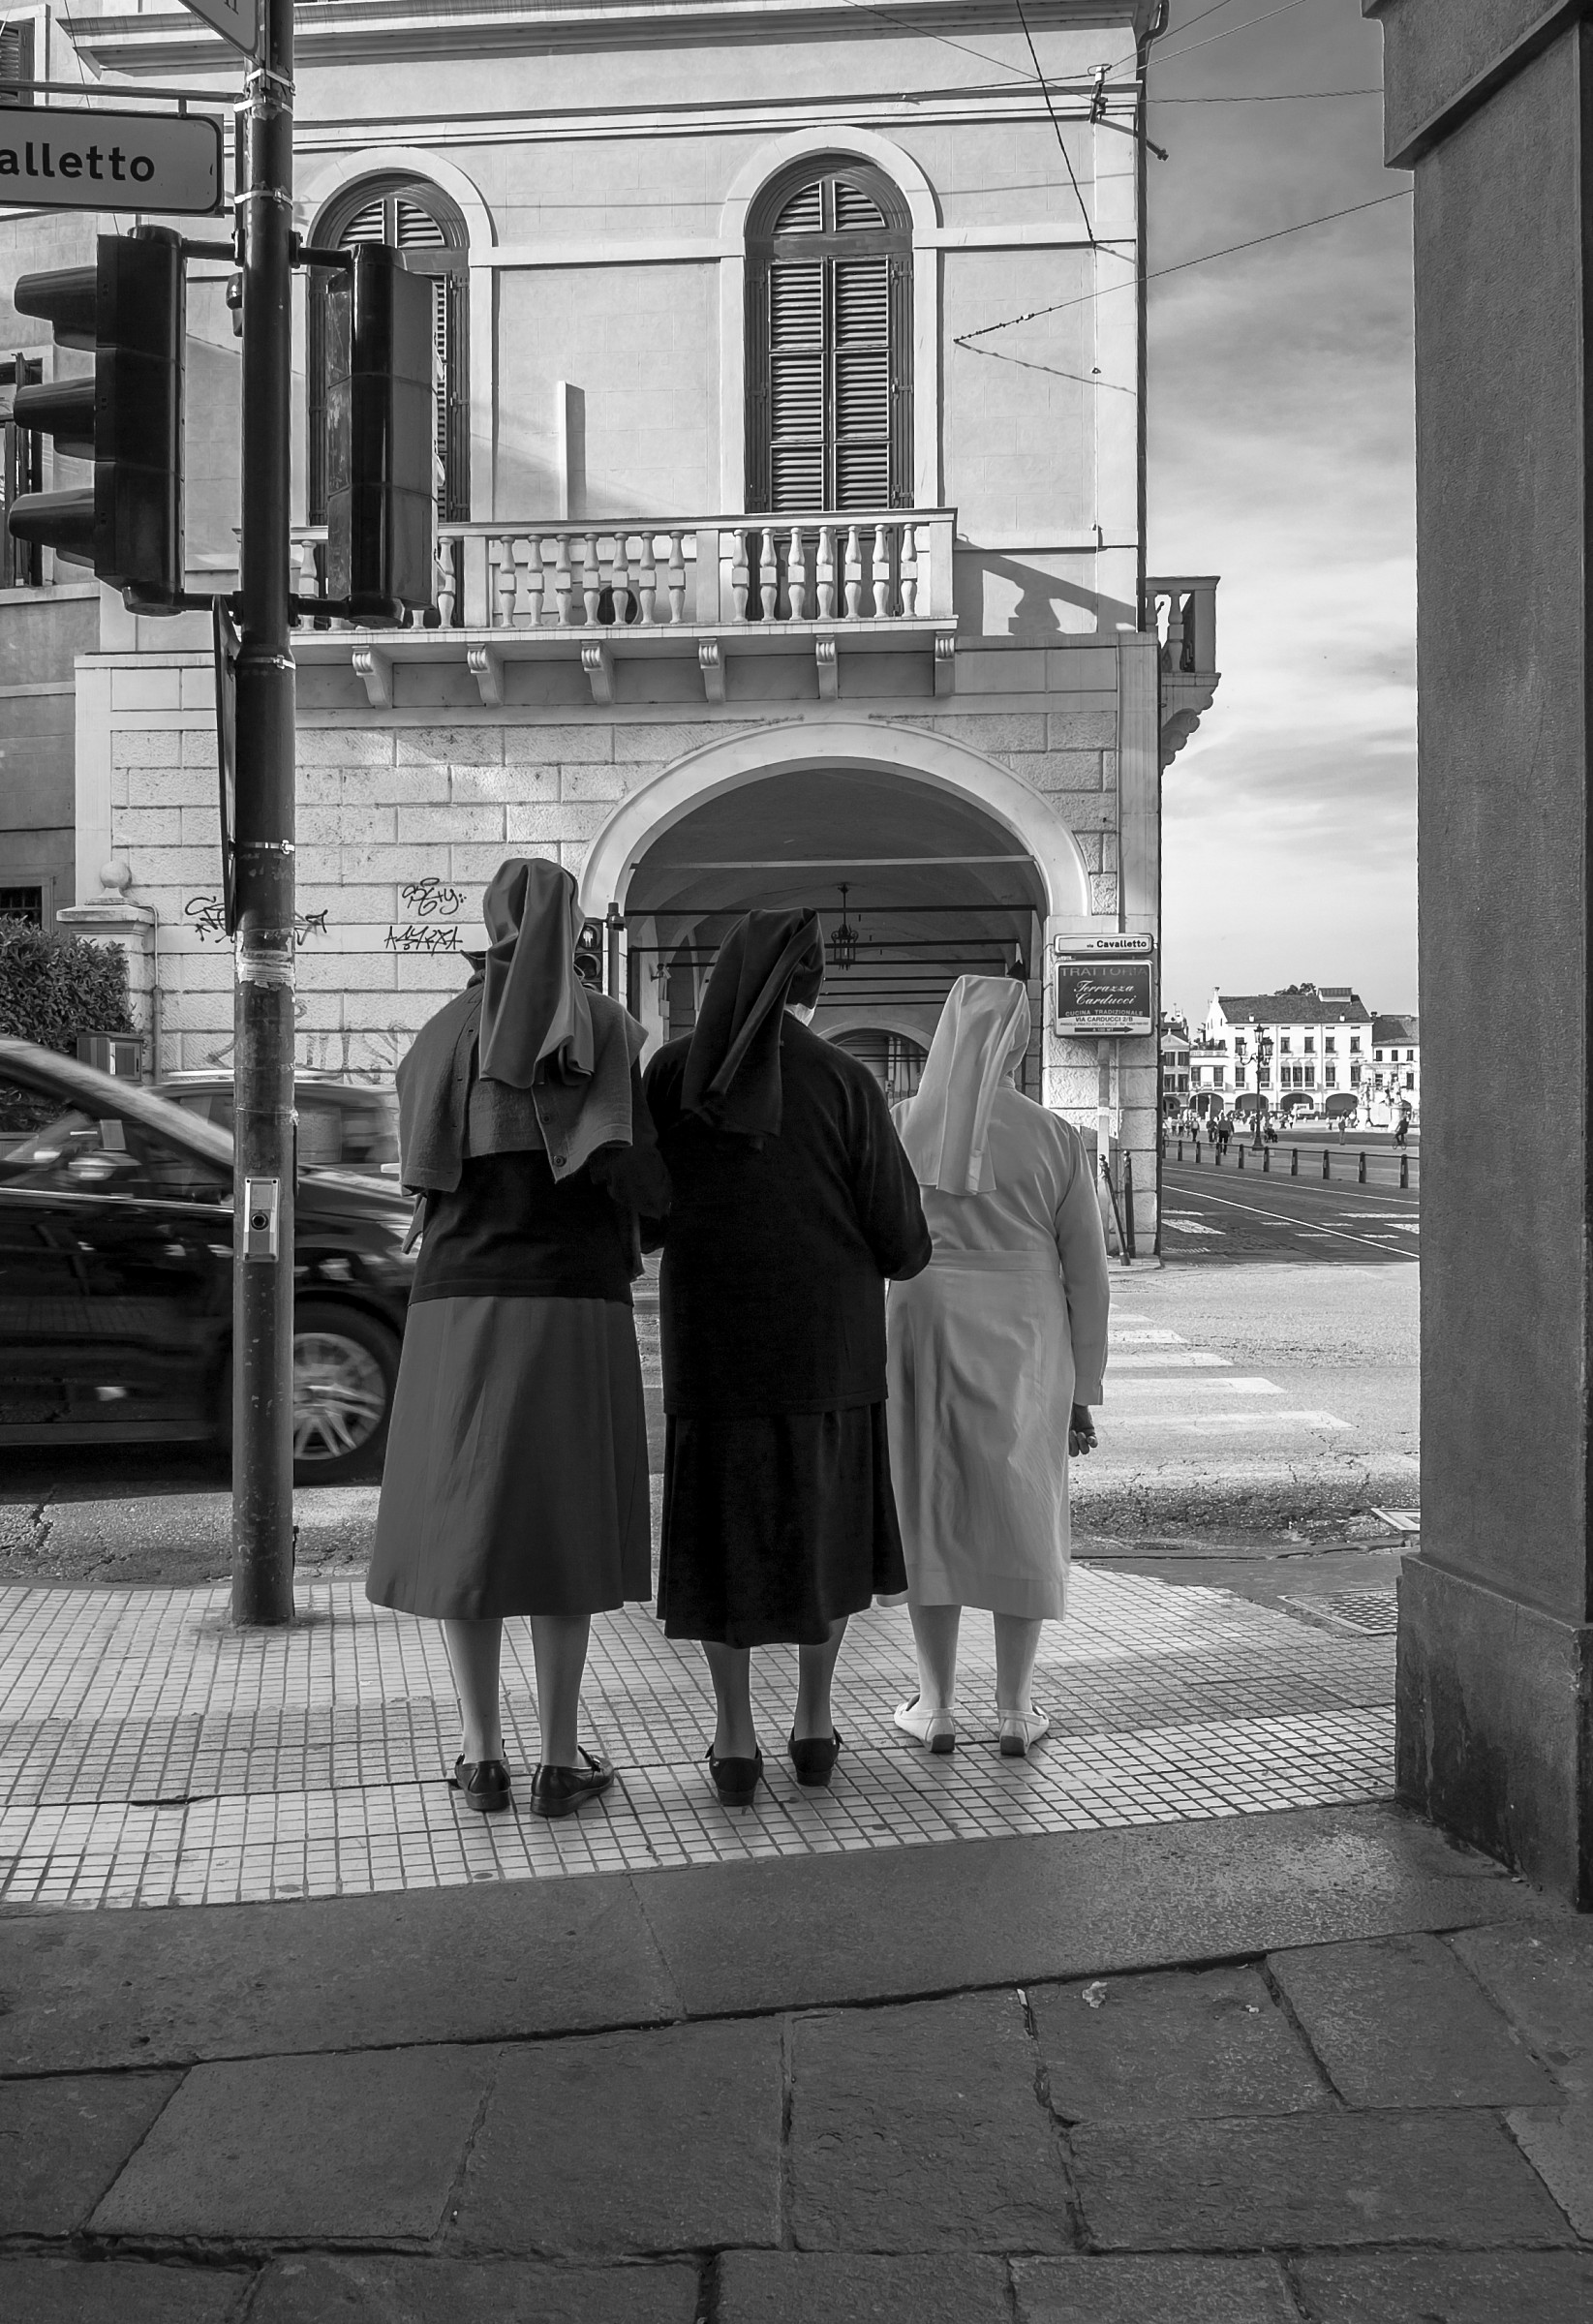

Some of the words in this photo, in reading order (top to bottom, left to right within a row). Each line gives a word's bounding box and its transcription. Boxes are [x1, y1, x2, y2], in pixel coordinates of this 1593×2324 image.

[0, 141, 155, 182] alletto
[1096, 939, 1147, 948] Cavalletto
[1060, 967, 1149, 977] TRATTORIA
[1073, 980, 1135, 993] Terrazza
[1075, 993, 1137, 1005] Carducci
